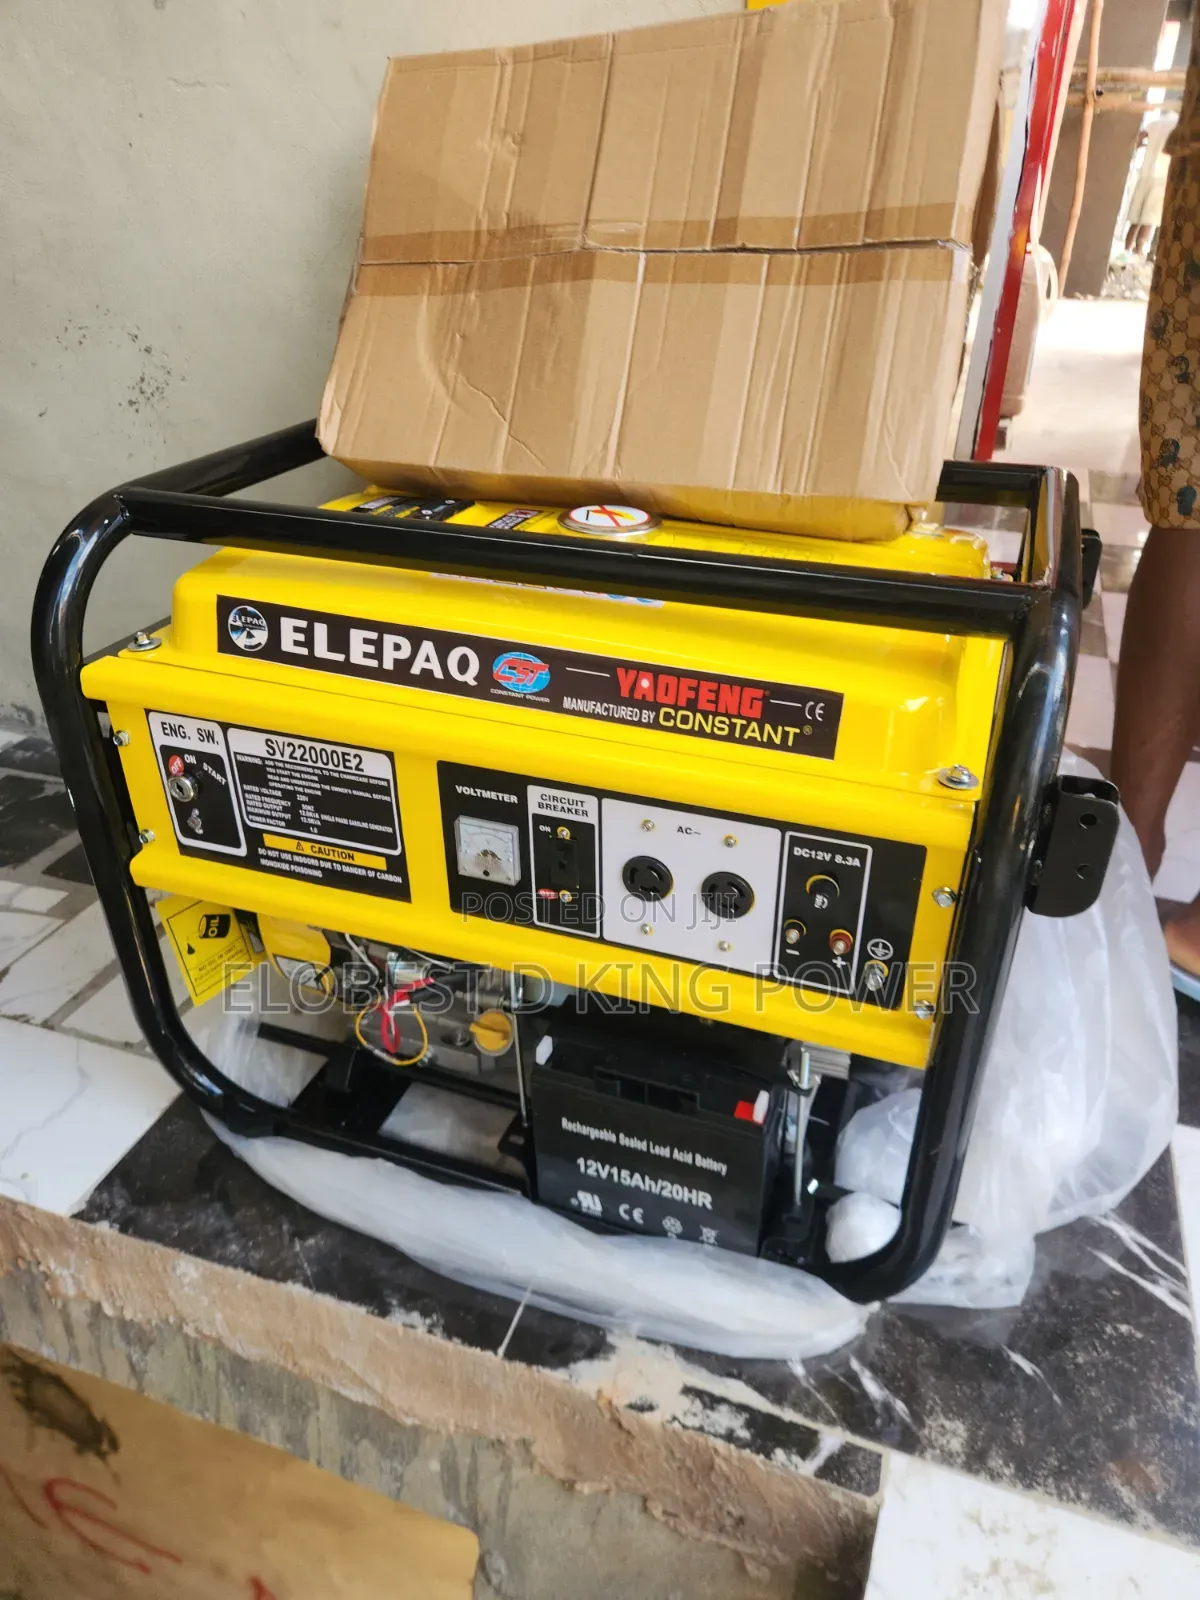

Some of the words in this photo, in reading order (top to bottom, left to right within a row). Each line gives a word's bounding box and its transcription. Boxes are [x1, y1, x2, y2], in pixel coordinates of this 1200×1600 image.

[232, 614, 266, 626] ELEPAQ
[280, 617, 480, 686] ELEPAQ
[493, 657, 550, 685] CST
[490, 688, 524, 698] CONSTANT
[526, 694, 550, 703] POWER
[616, 667, 764, 718] YAOFENG
[563, 696, 640, 722] MANUFACTURED
[641, 710, 656, 724] BY
[805, 701, 825, 721] CE
[160, 721, 191, 740] ENG.
[197, 728, 220, 745] SW.
[184, 754, 196, 764] ON
[265, 738, 364, 772] SV22000E2
[170, 757, 183, 774] OFF
[203, 762, 227, 785] START
[236, 754, 263, 765] WARNING:
[369, 778, 388, 787] BEFORE
[276, 768, 290, 776] START
[243, 784, 259, 792] RATED
[260, 788, 282, 797] VOLTAGE
[268, 782, 294, 790] OPERATING
[304, 788, 322, 796] ENGINE
[290, 778, 320, 788] UNDERSTAND
[331, 786, 352, 794] OWNER'S
[352, 790, 372, 798] MANUAL
[372, 794, 391, 802] BEFORE
[455, 784, 518, 804] VOLTMETER
[244, 793, 261, 801] RATED
[262, 796, 291, 807] FREQUENCY
[246, 800, 262, 808] RATED
[263, 803, 282, 812] OUTPUT
[538, 801, 589, 818] BREAKER
[540, 793, 586, 808] CIRCUIT
[247, 806, 270, 815] MAXIMUM
[272, 811, 292, 820] OUTPUT
[248, 815, 266, 824] POWER
[266, 818, 286, 828] FACTOR
[320, 814, 335, 822] SINGLE
[336, 816, 348, 825] PHASE
[349, 819, 368, 829] GASOLINE
[369, 823, 393, 834] GENERATOR
[539, 824, 551, 833] ON
[310, 845, 355, 861] CAUTION
[794, 846, 832, 862] DC12V
[834, 854, 861, 867] 8.3A
[258, 848, 266, 856] DO
[268, 850, 279, 858] NOT
[280, 852, 292, 861] USE
[293, 855, 319, 867] INDOORS
[320, 860, 332, 870] DUE
[333, 862, 341, 871] TO
[342, 865, 367, 877] DANGER
[368, 870, 375, 878] OF
[376, 871, 402, 884] CARBON
[260, 858, 290, 870] MONOXIDE
[290, 864, 322, 878] POISONING
[208, 916, 219, 937] OIL
[562, 1117, 616, 1143] Rechargeable
[618, 1132, 647, 1152] Sealed
[650, 1141, 670, 1158] Lead
[673, 1148, 692, 1165] Acid
[695, 1153, 728, 1177] Battery
[576, 1157, 713, 1210] 12V15Ah/20HR
